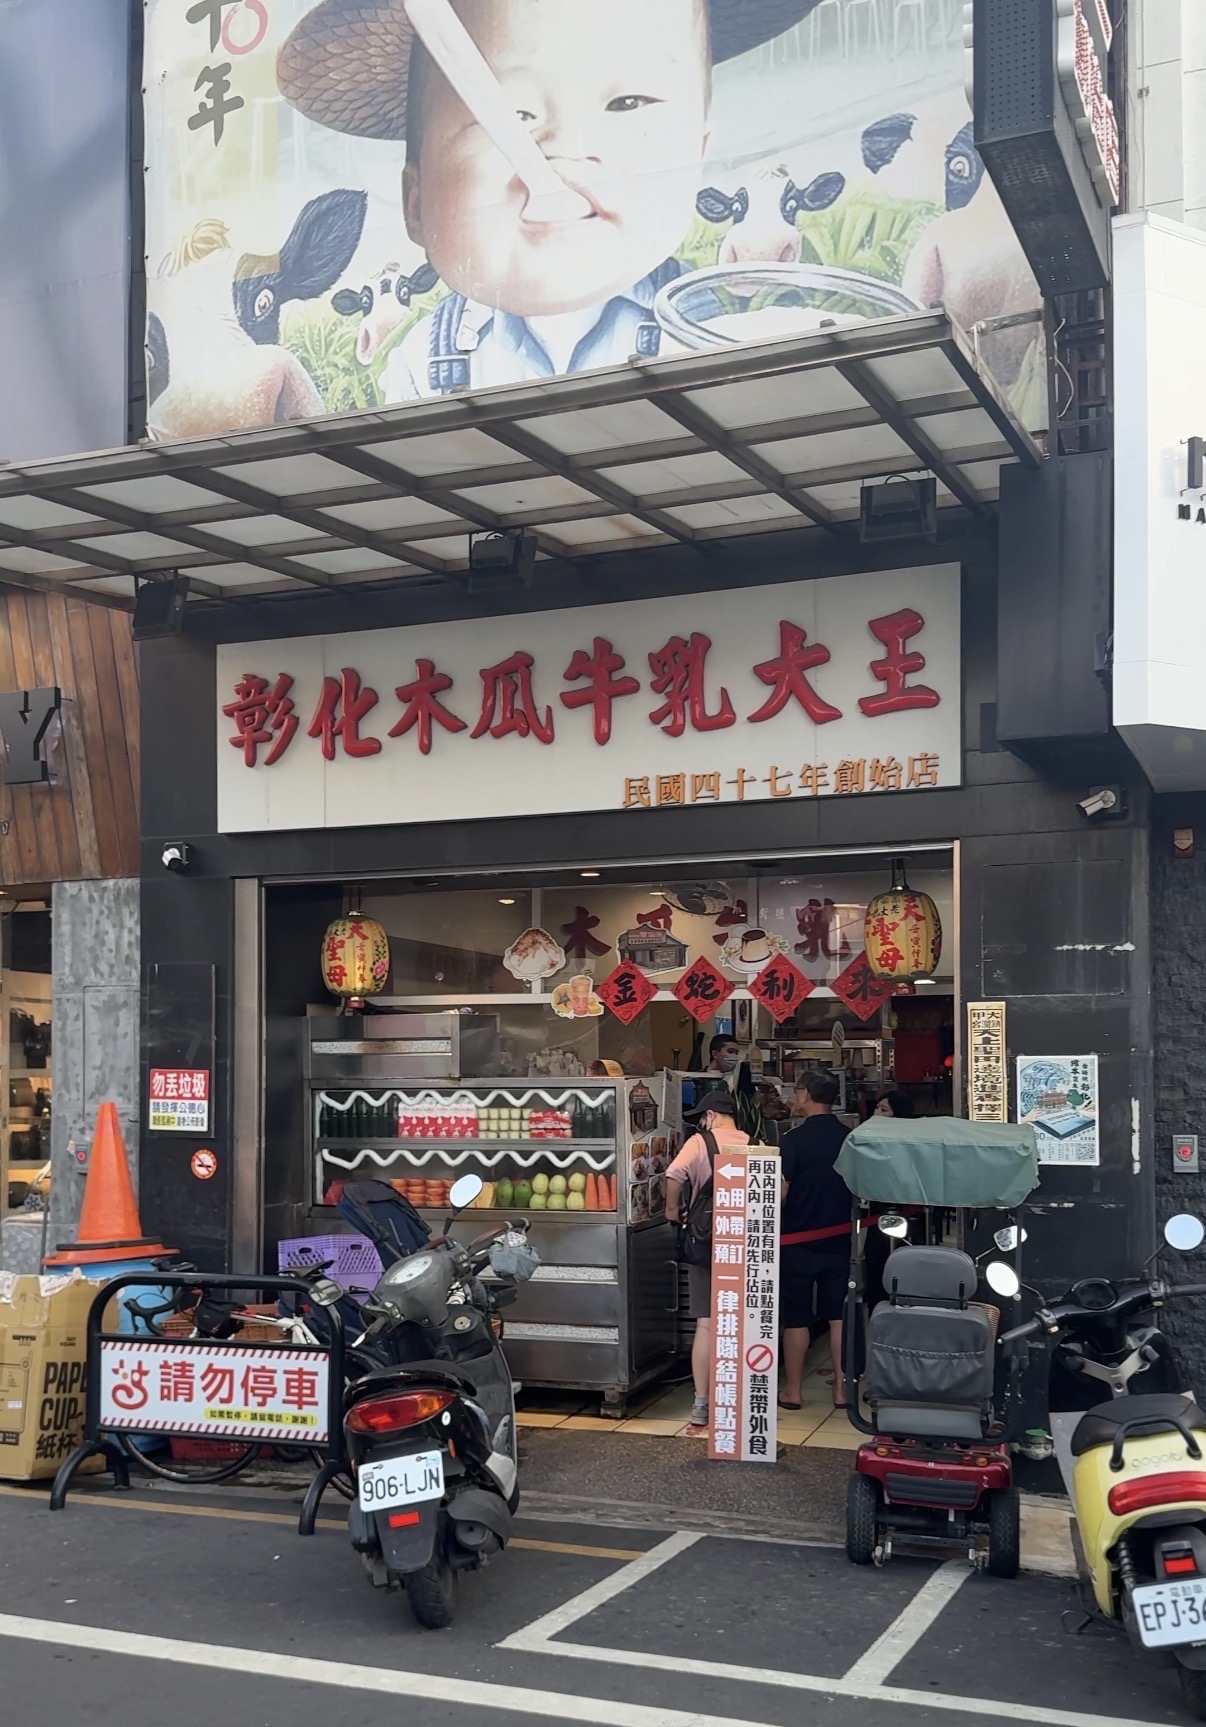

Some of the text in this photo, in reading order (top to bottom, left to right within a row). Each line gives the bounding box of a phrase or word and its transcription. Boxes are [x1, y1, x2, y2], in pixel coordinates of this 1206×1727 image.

[222, 608, 941, 768] 彰化木瓜牛乳大王
[622, 752, 940, 808] 民國四十七年創始店
[153, 1073, 205, 1097] 勿丟垃圾
[715, 1216, 744, 1236] 外帶
[715, 1244, 744, 1264] 預訂
[159, 1360, 319, 1410] 請勿停車
[40, 1397, 78, 1431] CUP
[748, 1374, 769, 1456] 禁帶外食
